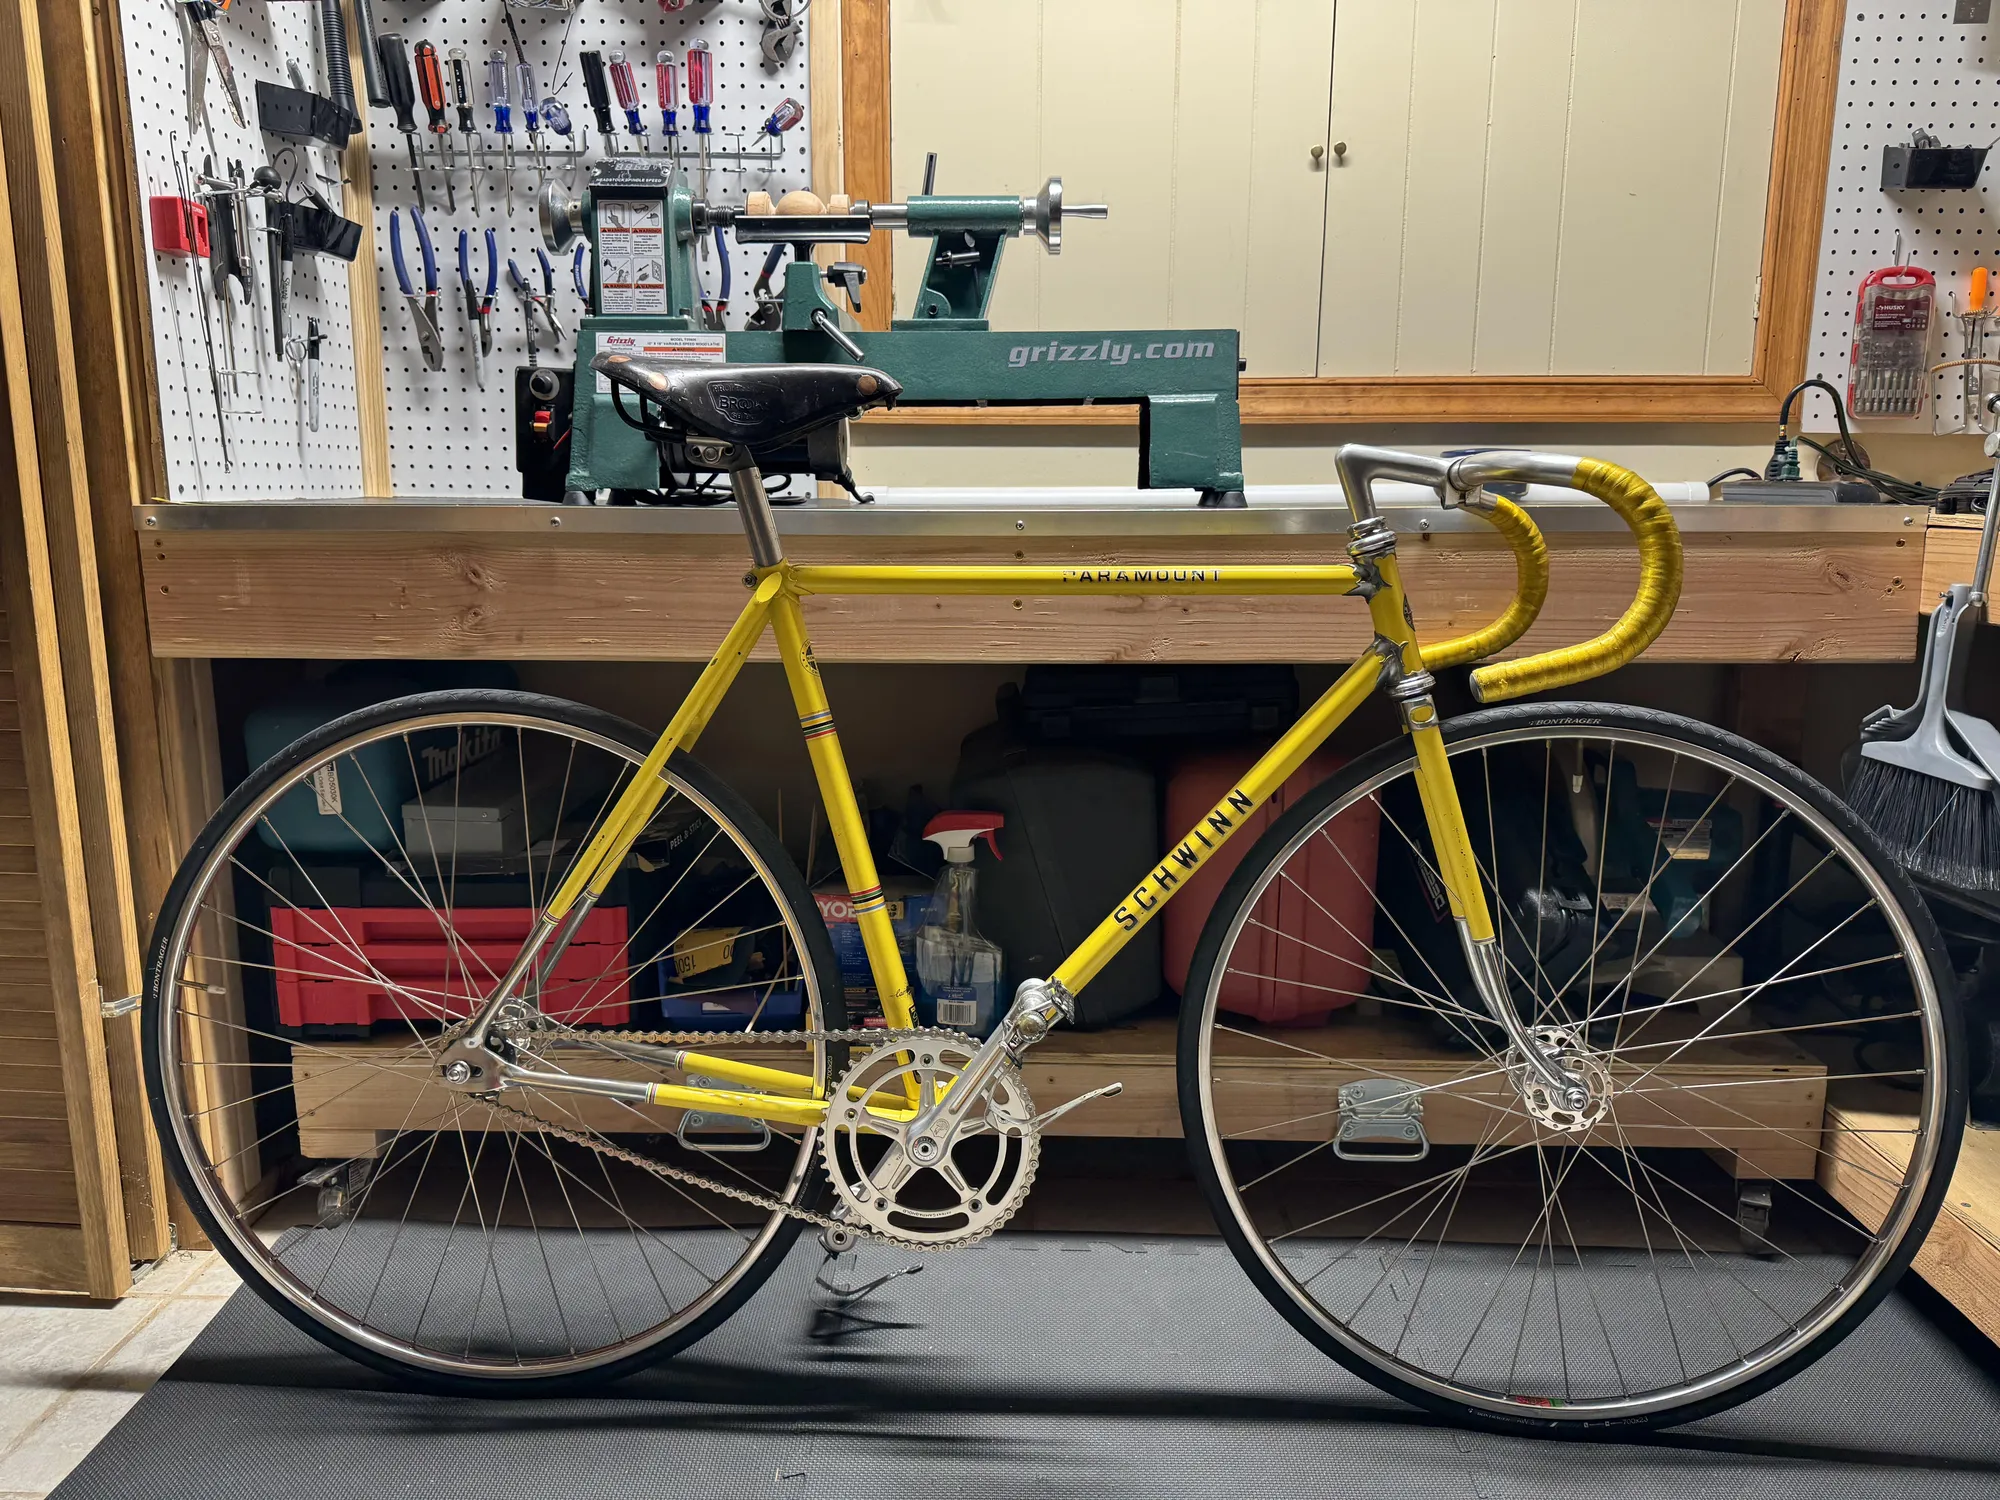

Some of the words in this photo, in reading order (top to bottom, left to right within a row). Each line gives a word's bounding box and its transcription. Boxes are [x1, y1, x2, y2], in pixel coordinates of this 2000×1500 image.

[607, 335, 636, 346] Grizzly
[1008, 340, 1215, 367] grizzly.com
[719, 395, 767, 410] BROOK
[1535, 717, 1601, 726] BONTRAGER
[1113, 788, 1254, 932] SCHWINN
[152, 936, 169, 992] BONTRAGER
